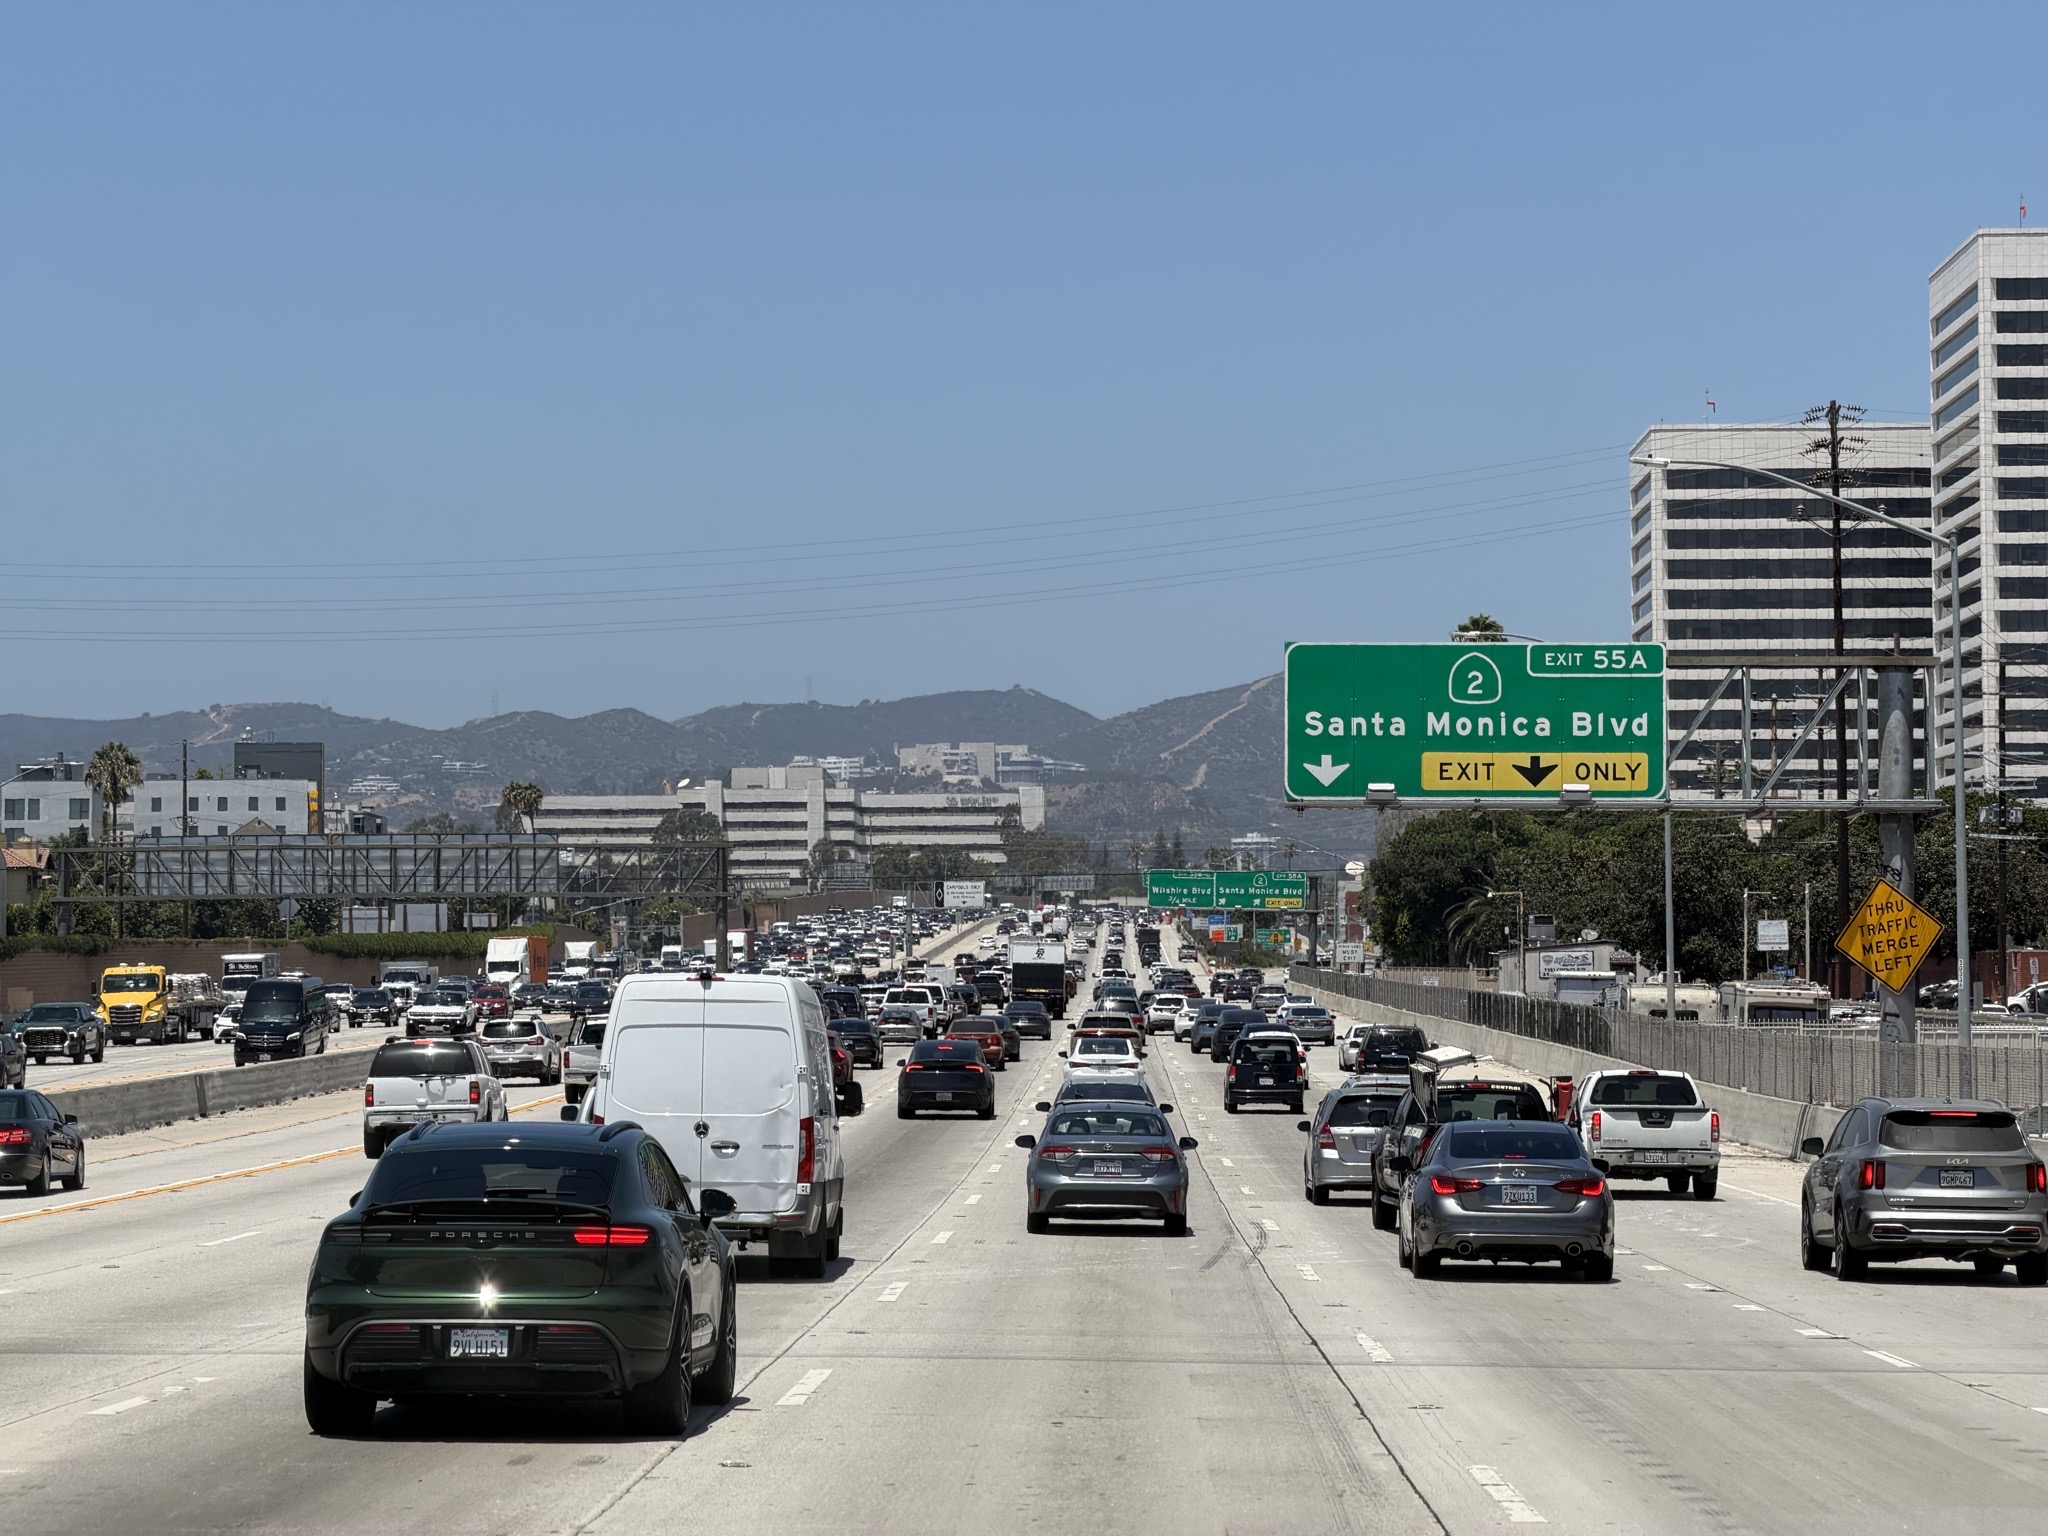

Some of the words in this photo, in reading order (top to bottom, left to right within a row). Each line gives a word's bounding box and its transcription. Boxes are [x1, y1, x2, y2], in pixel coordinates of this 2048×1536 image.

[1544, 653, 1582, 666] EXIT
[1593, 650, 1647, 669] 55A
[1467, 670, 1484, 694] 2
[1304, 711, 1406, 737] Santa
[1427, 711, 1551, 737] Monica
[1572, 711, 1648, 737] Blvd
[1438, 762, 1495, 781] EXIT
[1575, 762, 1642, 781] ONLY
[1257, 877, 1264, 885] 2
[1152, 886, 1188, 894] Wilshire
[1191, 887, 1211, 895] Blvd
[1248, 887, 1280, 895] Monica
[1283, 887, 1303, 895] Blvd
[1866, 900, 1904, 918] THRU
[1858, 915, 1918, 937] TRAFFIC
[1862, 935, 1919, 956] MERGE
[1874, 955, 1913, 973] LEFT
[1941, 1175, 1972, 1185] 9GMP467
[1504, 1191, 1535, 1201] 9ZKU133
